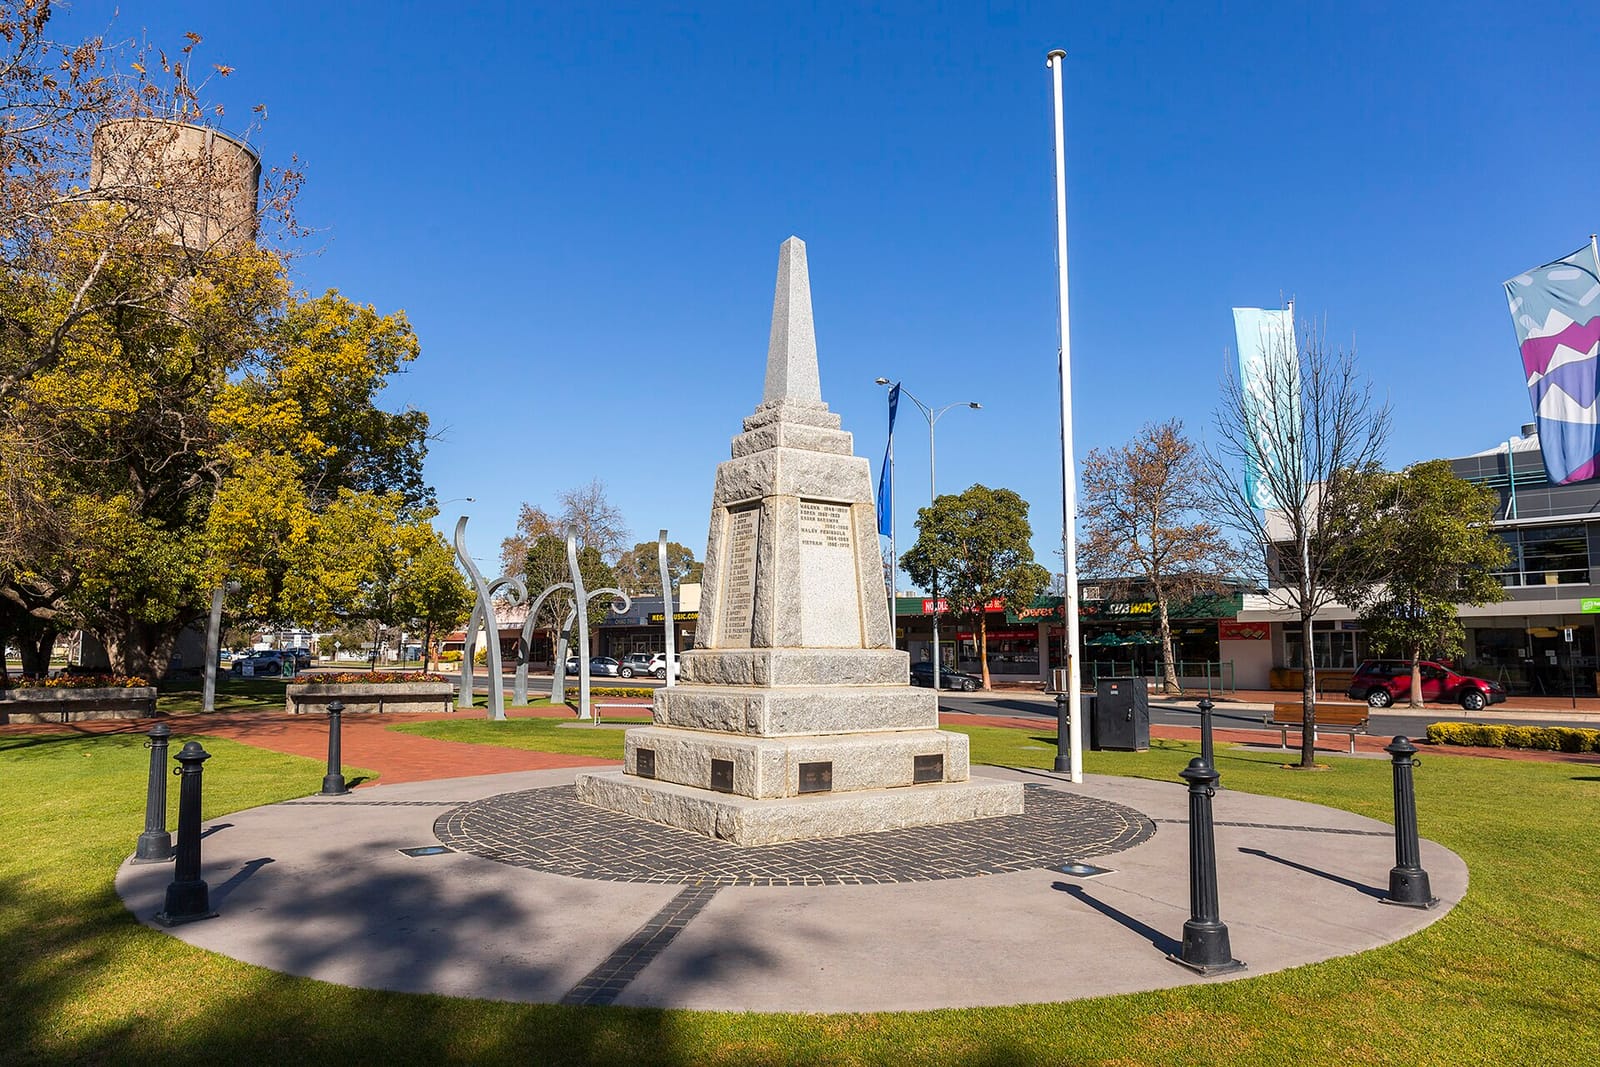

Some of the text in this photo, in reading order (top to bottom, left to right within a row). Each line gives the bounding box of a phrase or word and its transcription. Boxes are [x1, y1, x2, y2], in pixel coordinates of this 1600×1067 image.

[925, 601, 948, 611] NODLE
[1106, 602, 1158, 615] SUBWAY
[651, 612, 699, 621] MEGUSIC.COM
